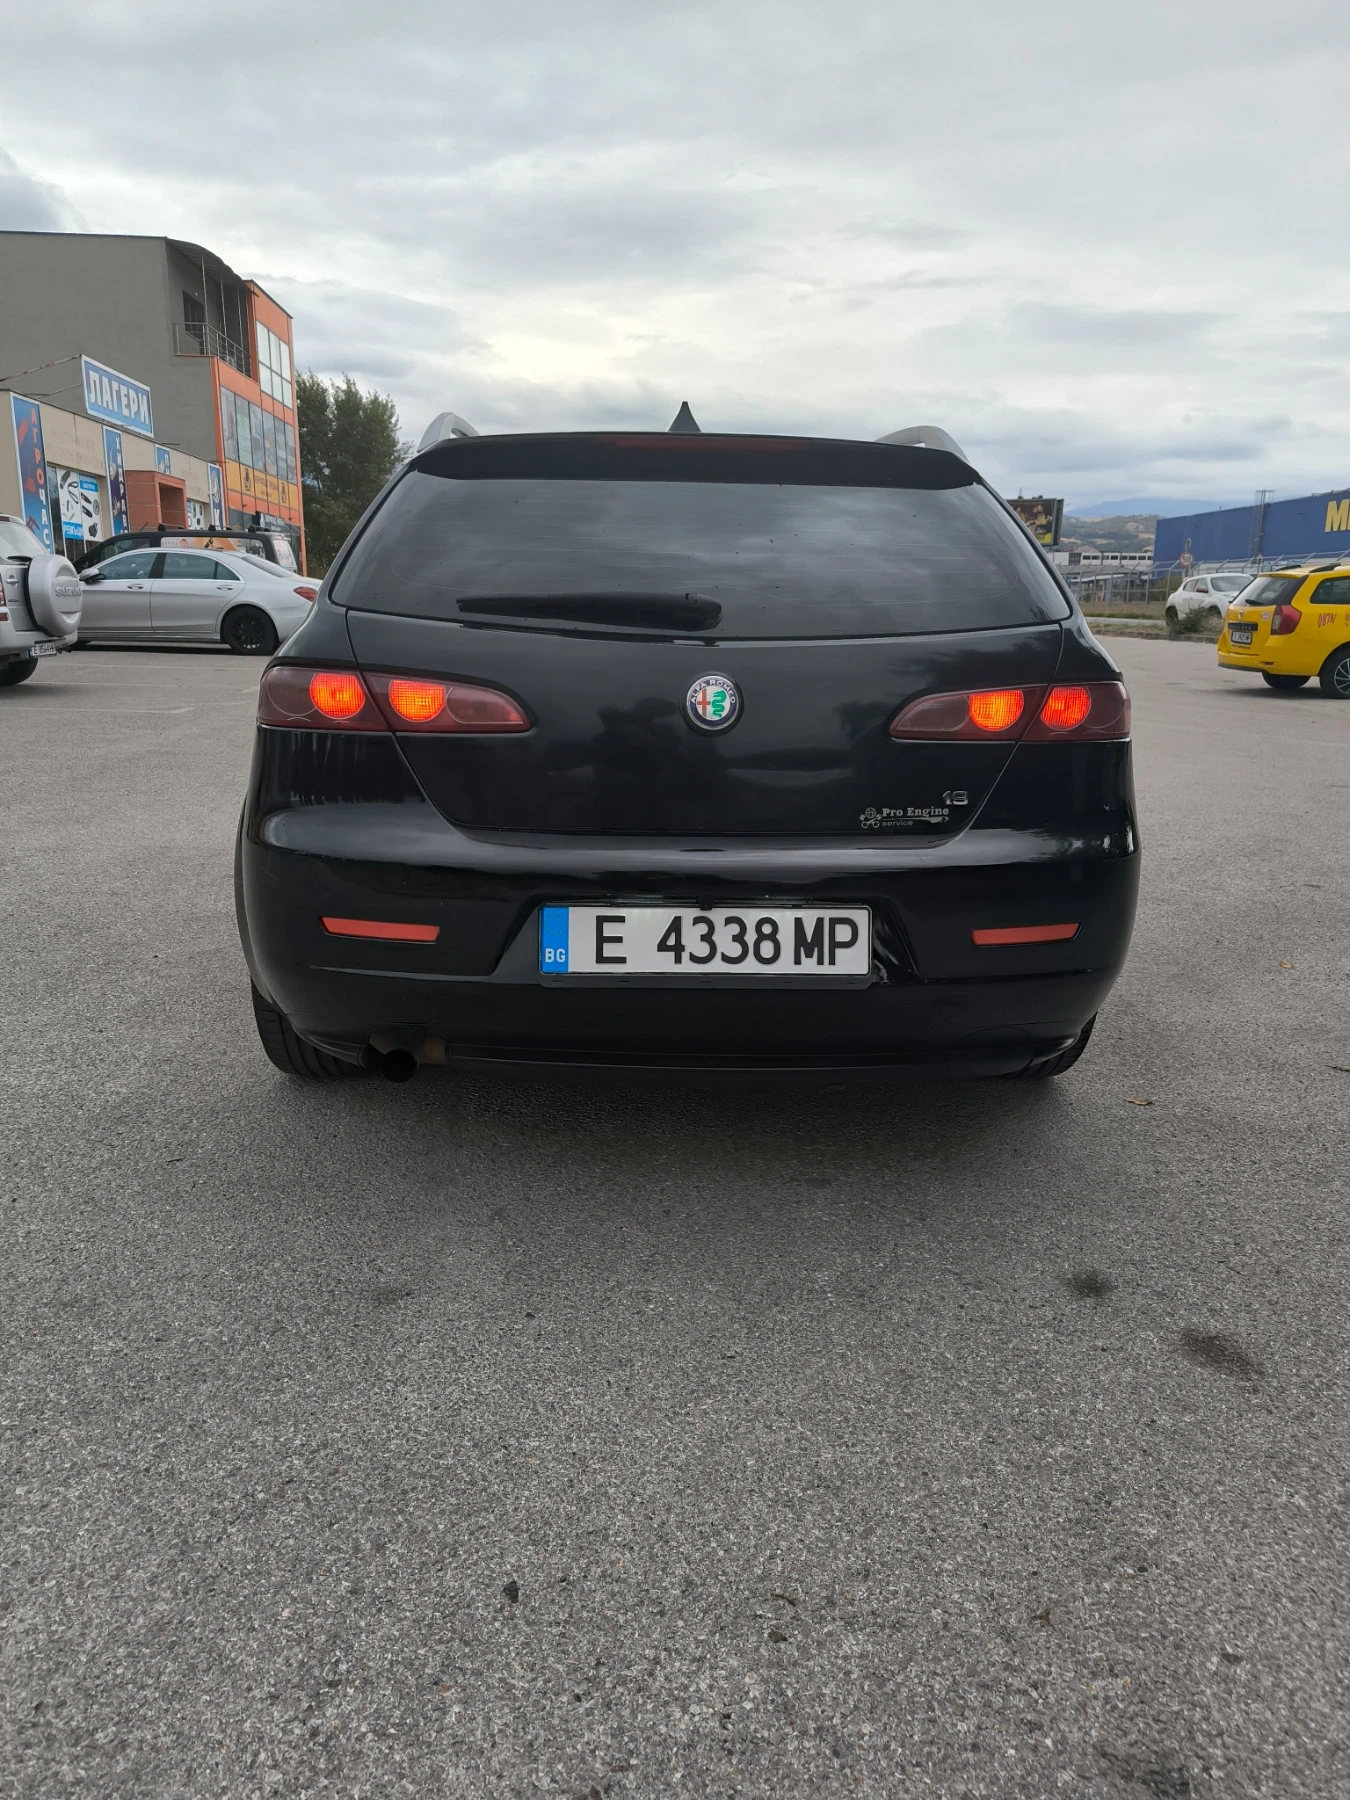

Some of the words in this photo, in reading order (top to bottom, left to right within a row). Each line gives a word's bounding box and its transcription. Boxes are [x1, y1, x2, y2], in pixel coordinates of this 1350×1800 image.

[89, 369, 149, 425] ЛАГЕРИ
[30, 408, 50, 550] АГРОЧАС
[1324, 499, 1350, 532] M
[1182, 555, 1191, 564] 50
[709, 680, 736, 703] ROMEO
[882, 808, 903, 817] Pro
[907, 806, 949, 816] Engine
[595, 915, 627, 964] E
[656, 915, 781, 965] 4338
[793, 917, 859, 966] MP
[544, 948, 566, 963] BG
